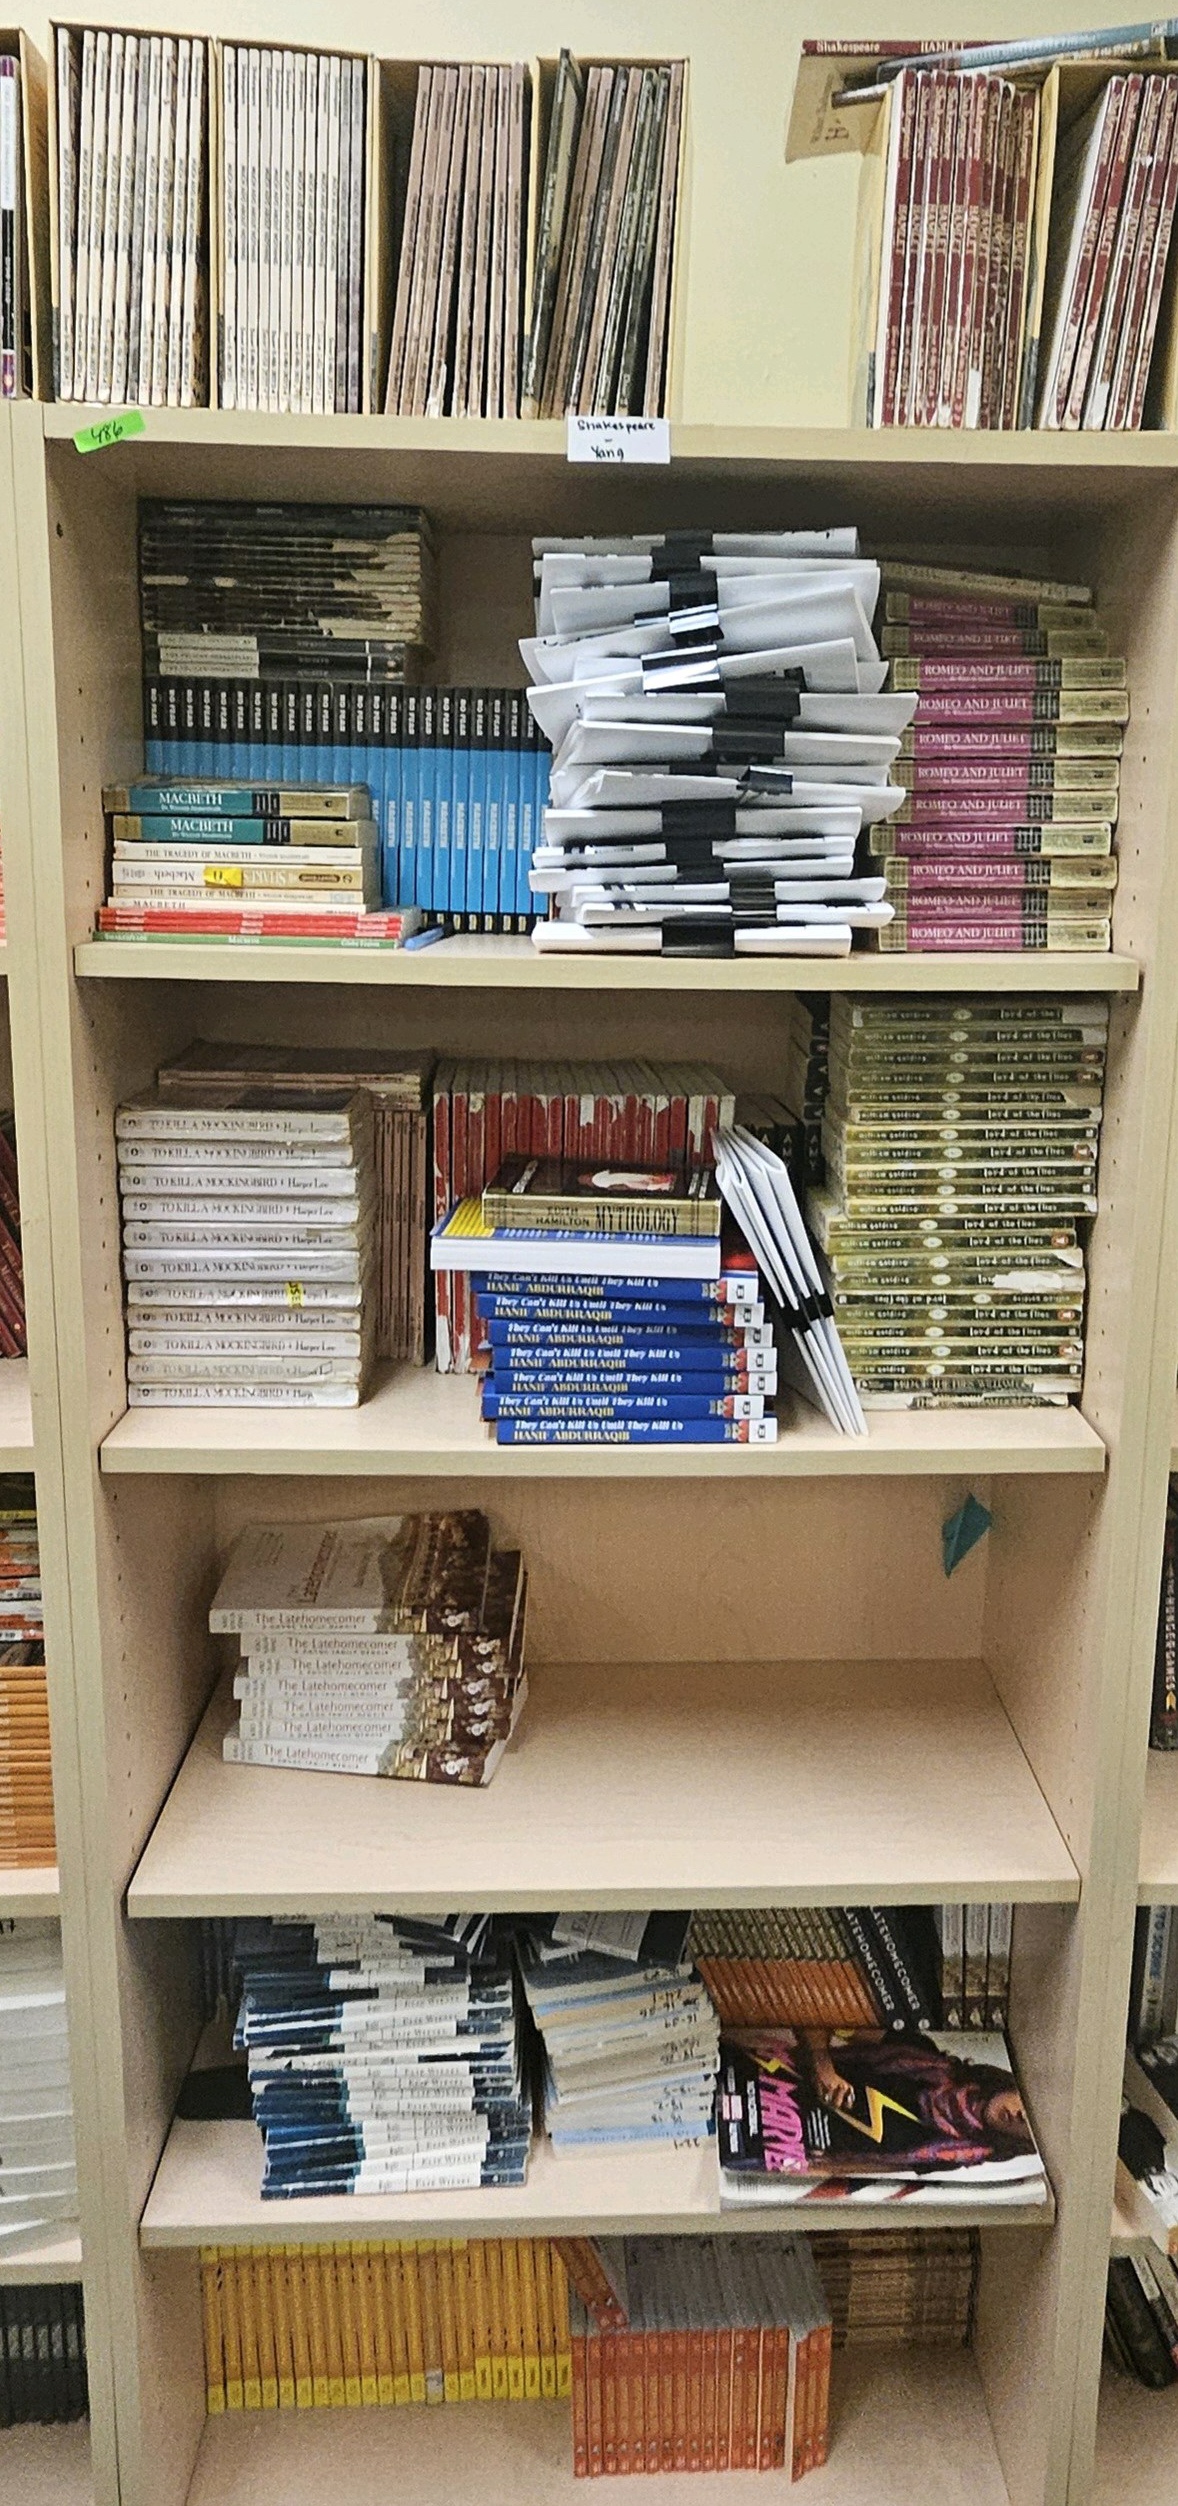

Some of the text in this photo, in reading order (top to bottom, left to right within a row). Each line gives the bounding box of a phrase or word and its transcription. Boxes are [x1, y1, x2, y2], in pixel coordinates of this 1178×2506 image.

[90, 421, 123, 443] 486
[577, 420, 656, 434] Shakespeare
[591, 446, 625, 460] Yang
[925, 665, 1030, 676] ROMEO AND JULIET
[919, 699, 1027, 709] ROMEO AND JULIET
[920, 734, 1025, 744] ROMEO AND JULIET
[918, 767, 1024, 778] ROMEO AND JULIET
[159, 792, 222, 805] MACBETH
[916, 800, 1021, 810] ROMEO AND JULIET
[170, 819, 233, 833] MACBETH
[145, 849, 159, 857] THE
[201, 850, 211, 858] OF
[214, 851, 252, 859] MACBETH
[154, 868, 195, 881] Macbeth
[913, 865, 1019, 875] ROMEO AND JULIET
[911, 928, 1017, 938] ROMEO AND JULIET
[988, 1110, 1008, 1119] lord
[985, 1130, 1005, 1138] lord
[154, 1177, 168, 1186] TO
[170, 1177, 193, 1186] KILL
[195, 1178, 203, 1186] A
[206, 1177, 277, 1187] MOCKINGBIRD
[535, 1217, 590, 1227] HAMILTON
[595, 1205, 679, 1235] MYTHOLOGY
[964, 1220, 984, 1229] lord
[165, 1313, 178, 1322] TO
[179, 1313, 201, 1323] KILL
[203, 1314, 211, 1323] A
[215, 1313, 285, 1323] MOCKINGBIRD
[165, 1341, 179, 1349] TO
[180, 1341, 201, 1350] KILL
[203, 1341, 212, 1350] A
[215, 1341, 285, 1350] MOCKINGBIRD
[510, 1348, 680, 1360] They Can't Kill Us Until They Kill Us
[510, 1359, 626, 1369] HANIF ABDURRAQIB
[515, 1420, 684, 1432] They Can't Kill Us Until They Kill Us
[513, 1430, 630, 1441] HANIF ABDURRAQIB
[256, 1613, 365, 1624] The Latehomecomer
[288, 1637, 398, 1648] The Latehomecomer
[292, 1658, 401, 1670] The Latehomecomer
[279, 1679, 387, 1690] The Latehomecomer
[283, 1721, 392, 1733] The Latehomecomer
